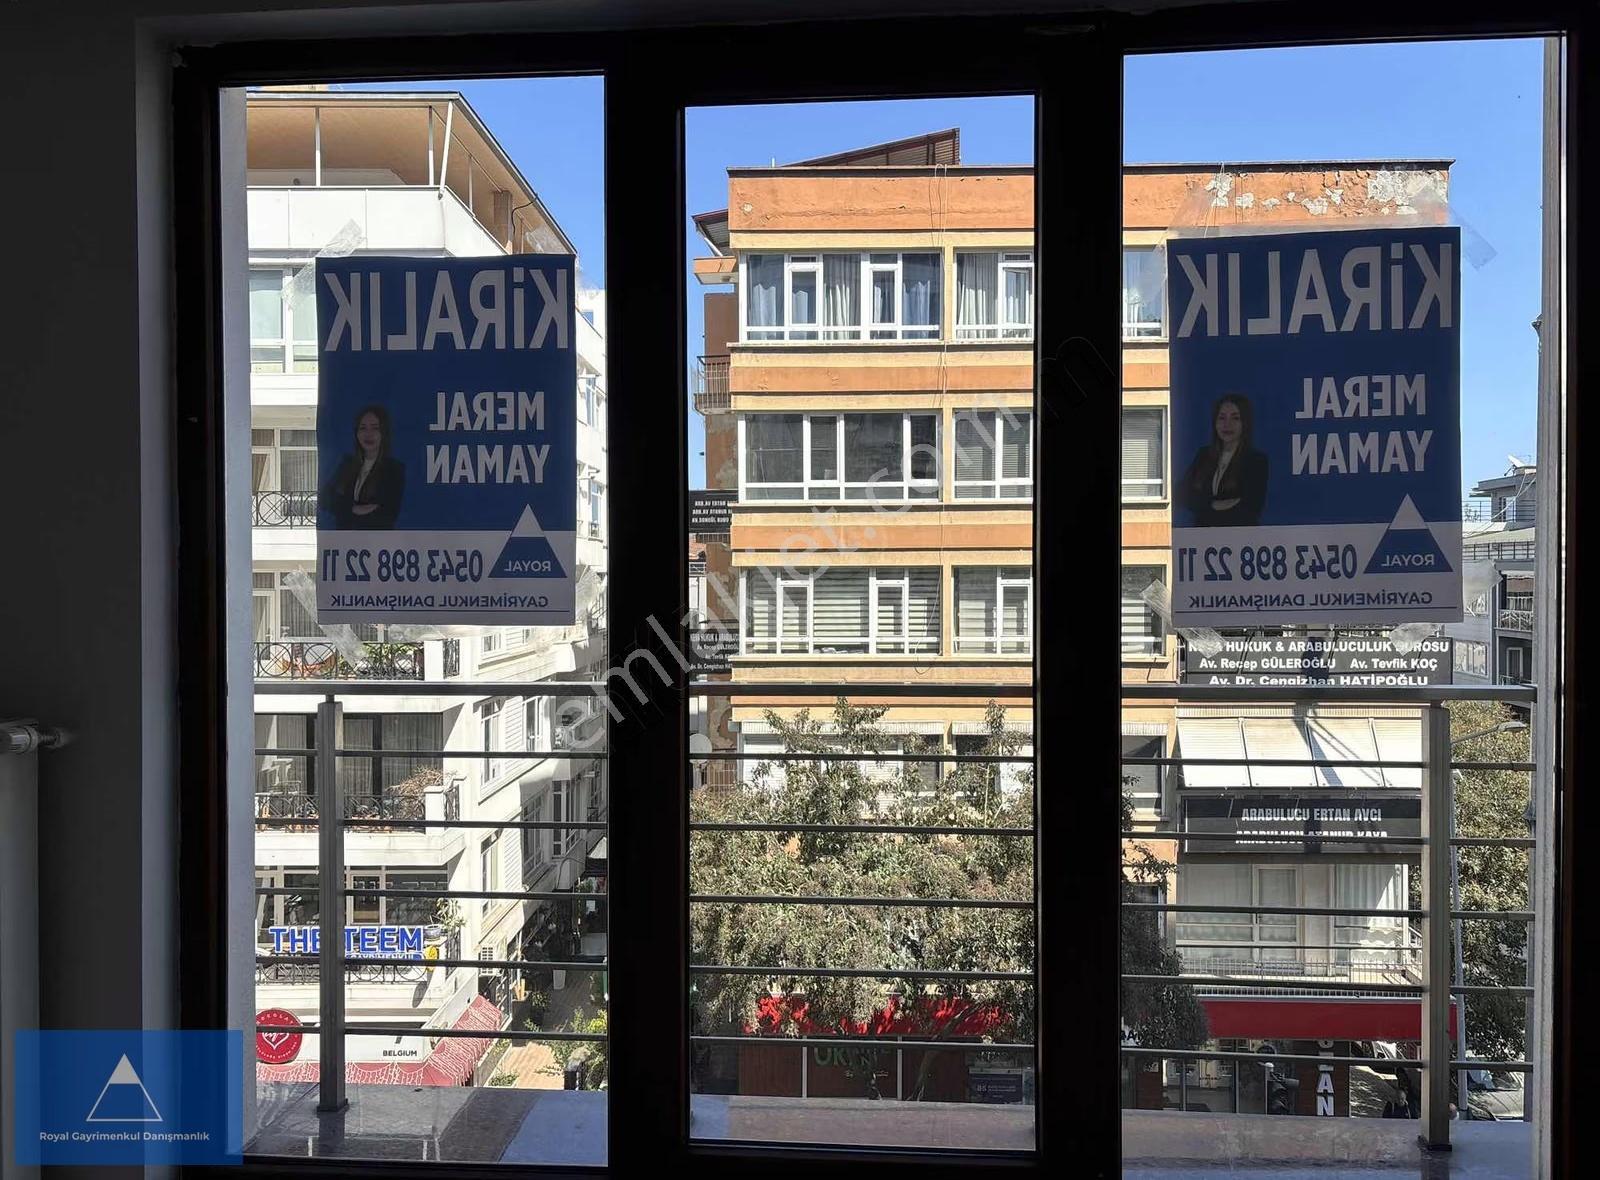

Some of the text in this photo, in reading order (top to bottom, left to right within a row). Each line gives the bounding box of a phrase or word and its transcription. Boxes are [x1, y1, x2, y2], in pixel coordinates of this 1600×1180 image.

[1226, 641, 1272, 652] HUKUK
[1275, 641, 1284, 652] &
[1288, 641, 1392, 652] ARABULUCULUK
[1395, 641, 1449, 652] ROSU
[1199, 656, 1438, 672] Av. Recep GÜLEROĞLU Av. Tevfik KOÇ
[1209, 676, 1230, 685] Av.
[1235, 676, 1255, 685] Dr.
[1340, 673, 1428, 685] HATİPOĞLU
[1241, 808, 1382, 821] ARABULUCU ERTAN AVCI
[268, 925, 424, 953] THE TEEM
[383, 1049, 418, 1057] BELGIUM
